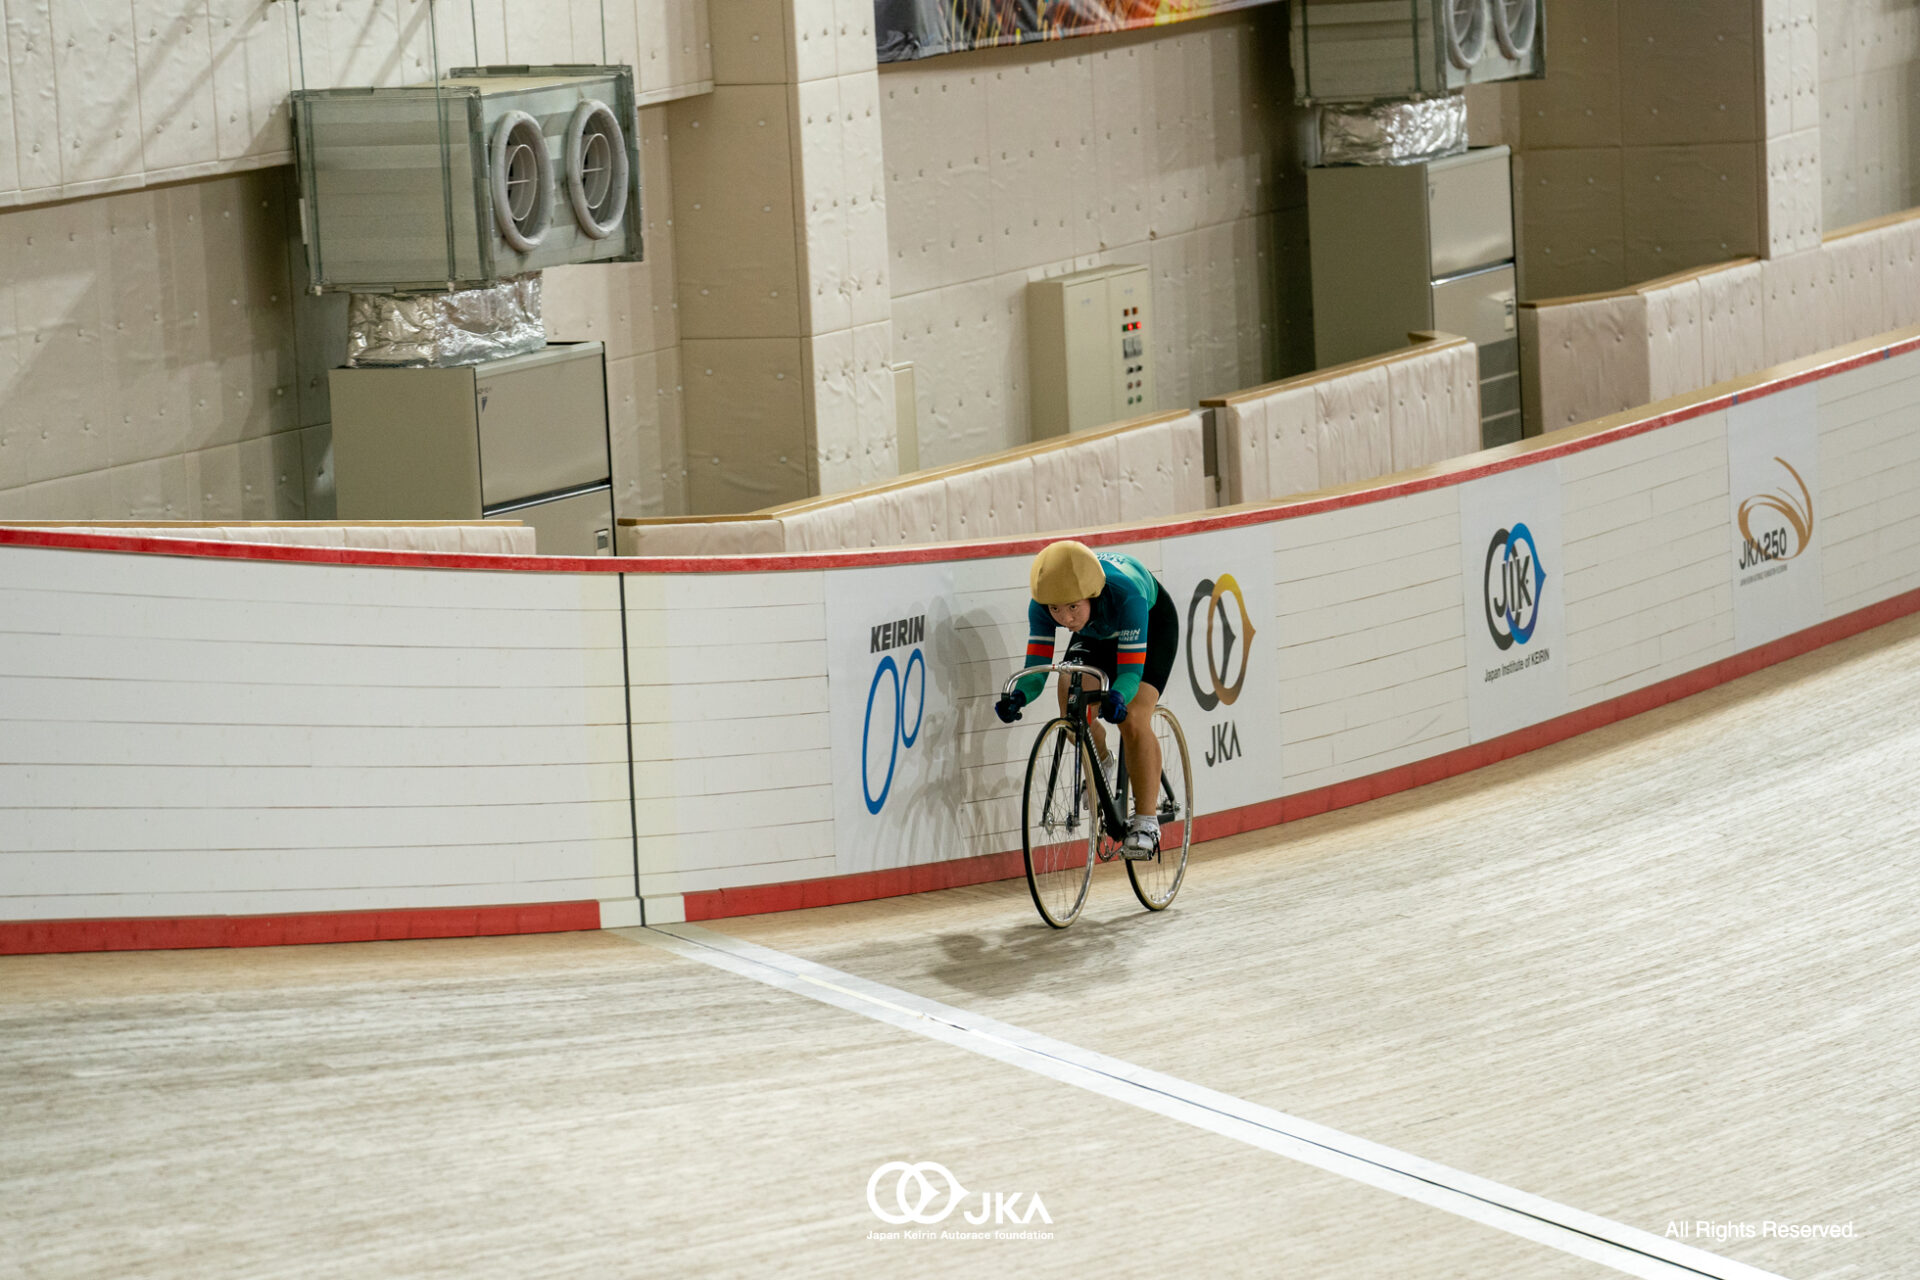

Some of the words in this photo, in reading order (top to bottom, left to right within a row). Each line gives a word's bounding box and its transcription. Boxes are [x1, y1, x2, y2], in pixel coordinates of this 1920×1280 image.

[1493, 555, 1533, 618] JIK
[870, 614, 925, 654] KEIRIN
[1485, 668, 1501, 683] Japan
[1502, 660, 1524, 676] Institute
[1525, 654, 1531, 668] of
[1532, 648, 1550, 665] KEIRIN
[1205, 720, 1242, 768] JKA
